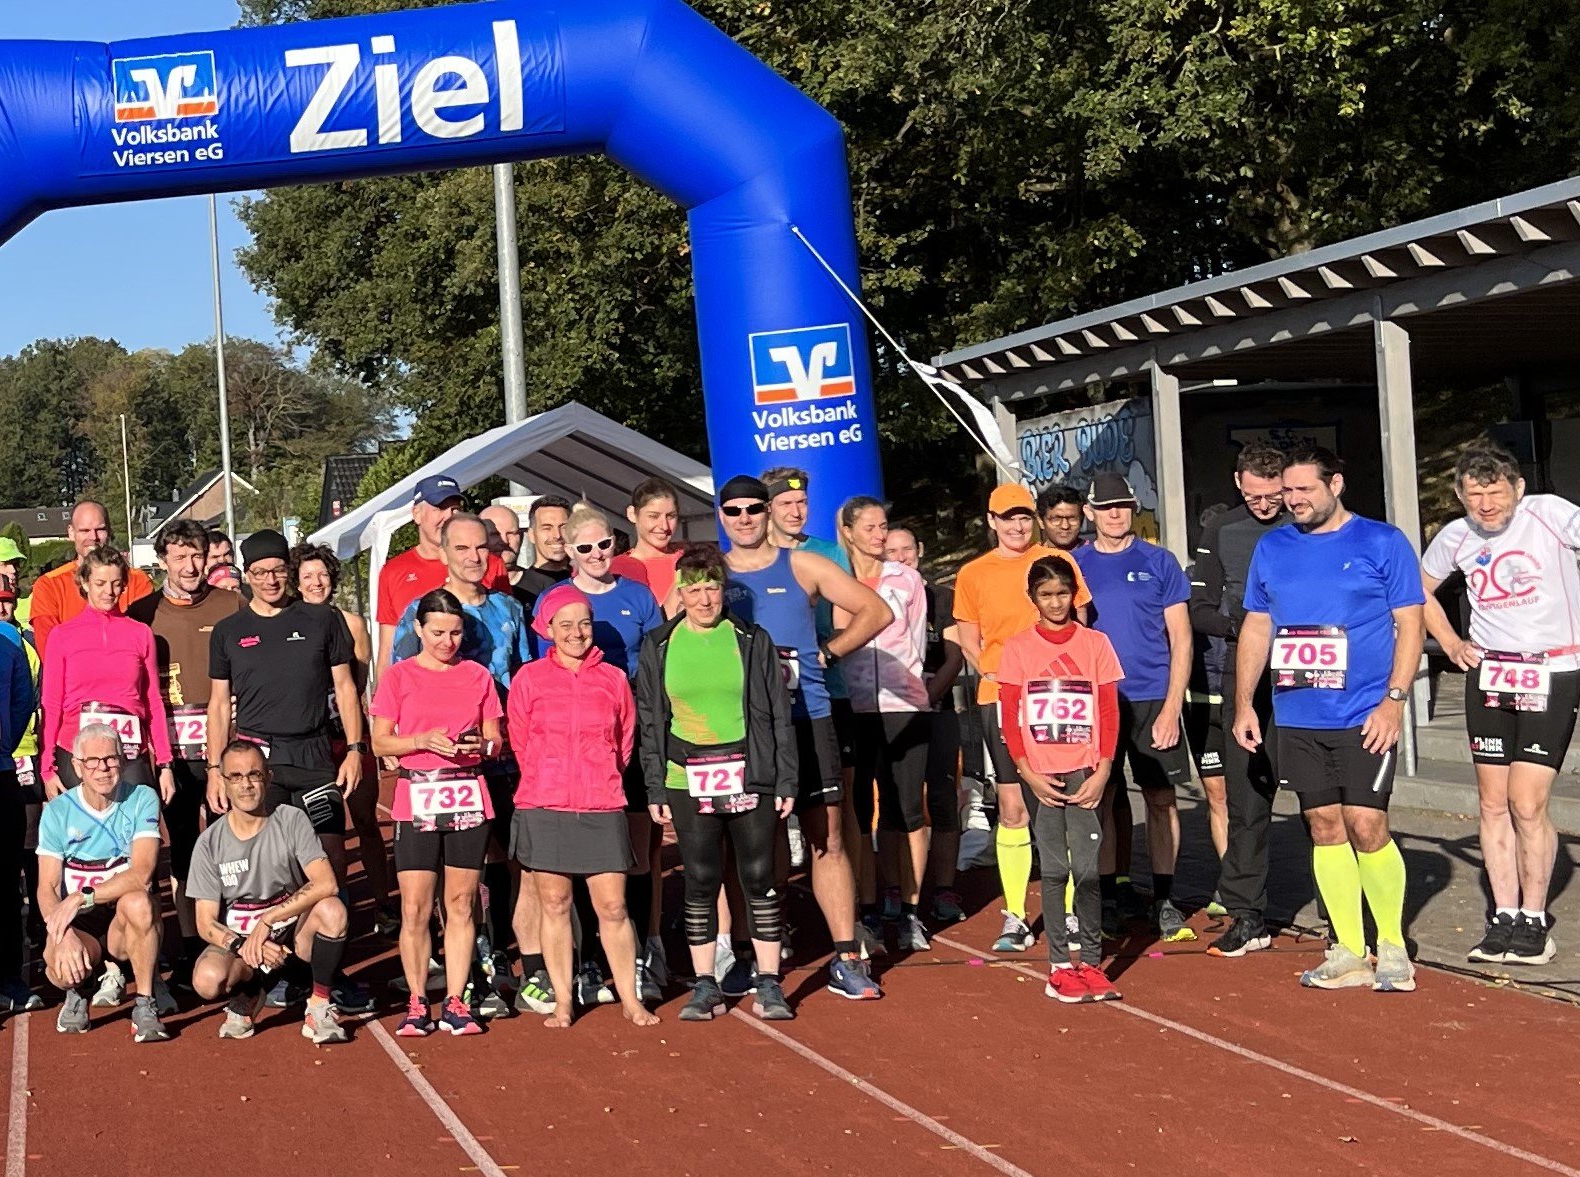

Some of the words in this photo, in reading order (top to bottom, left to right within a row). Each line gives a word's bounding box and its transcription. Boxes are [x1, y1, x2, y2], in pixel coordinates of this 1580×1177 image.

[285, 20, 524, 154] Ziel
[112, 120, 219, 147] Volksbank
[113, 147, 189, 168] Viersen
[195, 142, 223, 161] eG
[752, 400, 858, 430] Volksbank
[754, 431, 835, 453] Viersen
[838, 424, 863, 444] eG
[1022, 422, 1070, 482] BIER
[1281, 643, 1337, 665] 705
[1488, 666, 1540, 688] 748
[1032, 698, 1087, 720] 762
[170, 720, 204, 740] 72
[693, 767, 744, 792] 721
[418, 785, 475, 810] 732
[219, 858, 249, 876] WHEW
